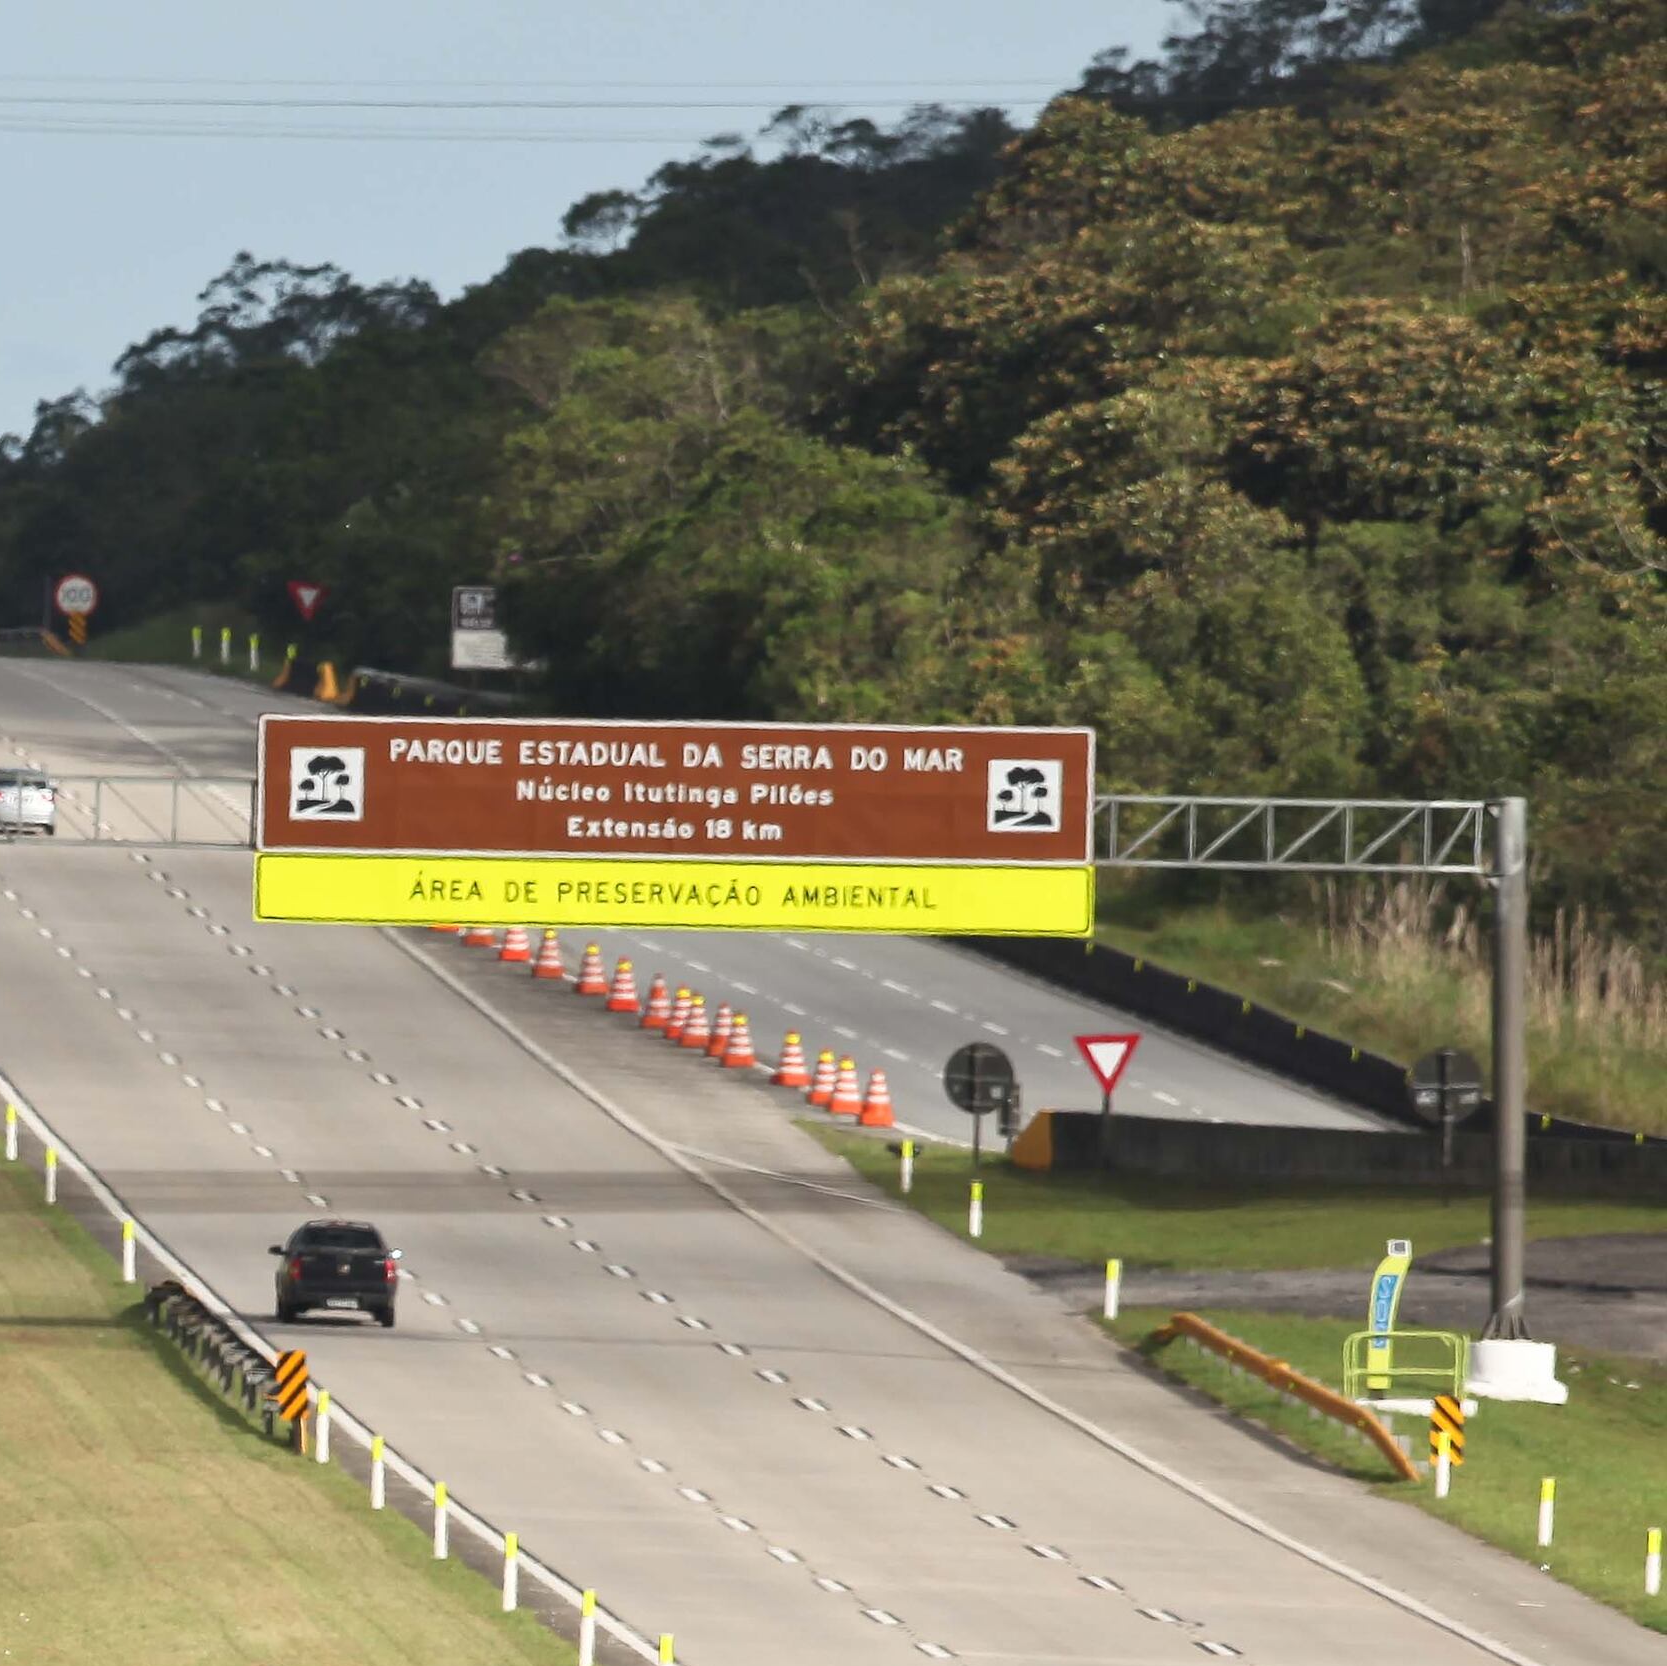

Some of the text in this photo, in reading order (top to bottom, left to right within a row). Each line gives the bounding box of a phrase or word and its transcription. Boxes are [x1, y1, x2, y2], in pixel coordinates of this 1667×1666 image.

[389, 738, 964, 772] PARQUE ESTADUAL DA SERRA DO MAR
[517, 776, 611, 802] Núcleo
[624, 781, 739, 808] Itutinga
[567, 815, 783, 841] Extensão 18 km
[409, 870, 937, 909] ÁREA DE PRESERVAÇÃO AMBIENTAL
